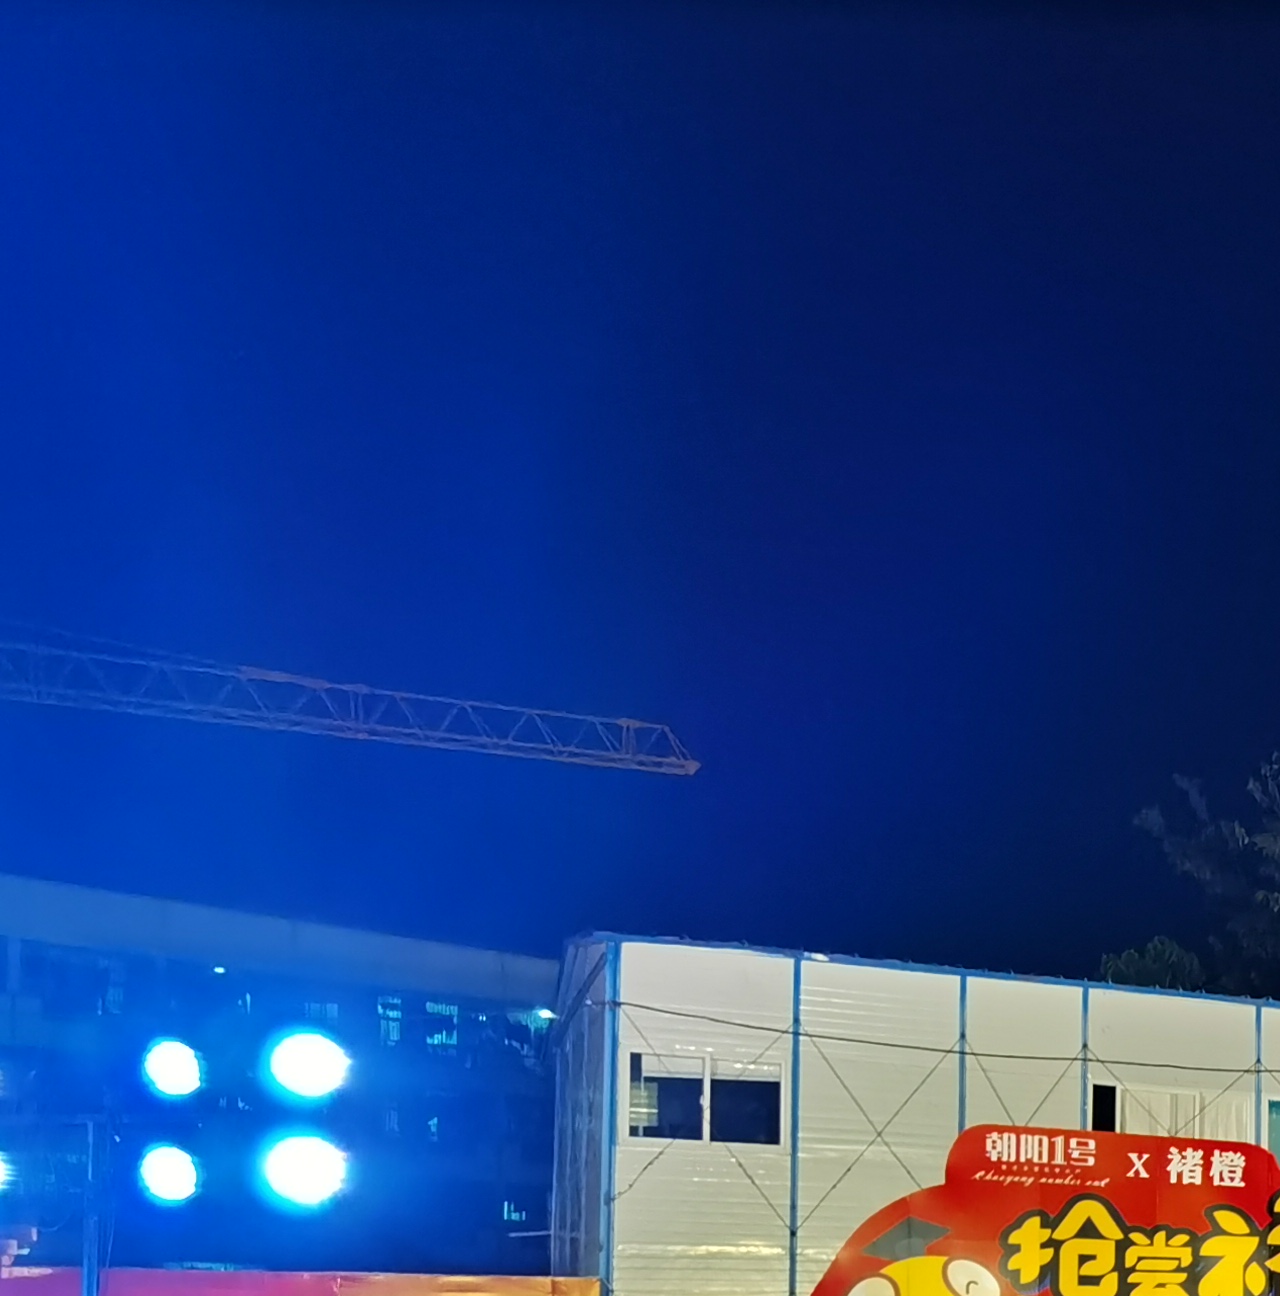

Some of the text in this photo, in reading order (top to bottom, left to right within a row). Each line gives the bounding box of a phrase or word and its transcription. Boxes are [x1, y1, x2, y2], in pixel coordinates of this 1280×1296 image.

[986, 1132, 1097, 1167] 朝阳1号
[1166, 1146, 1247, 1188] 褚橙
